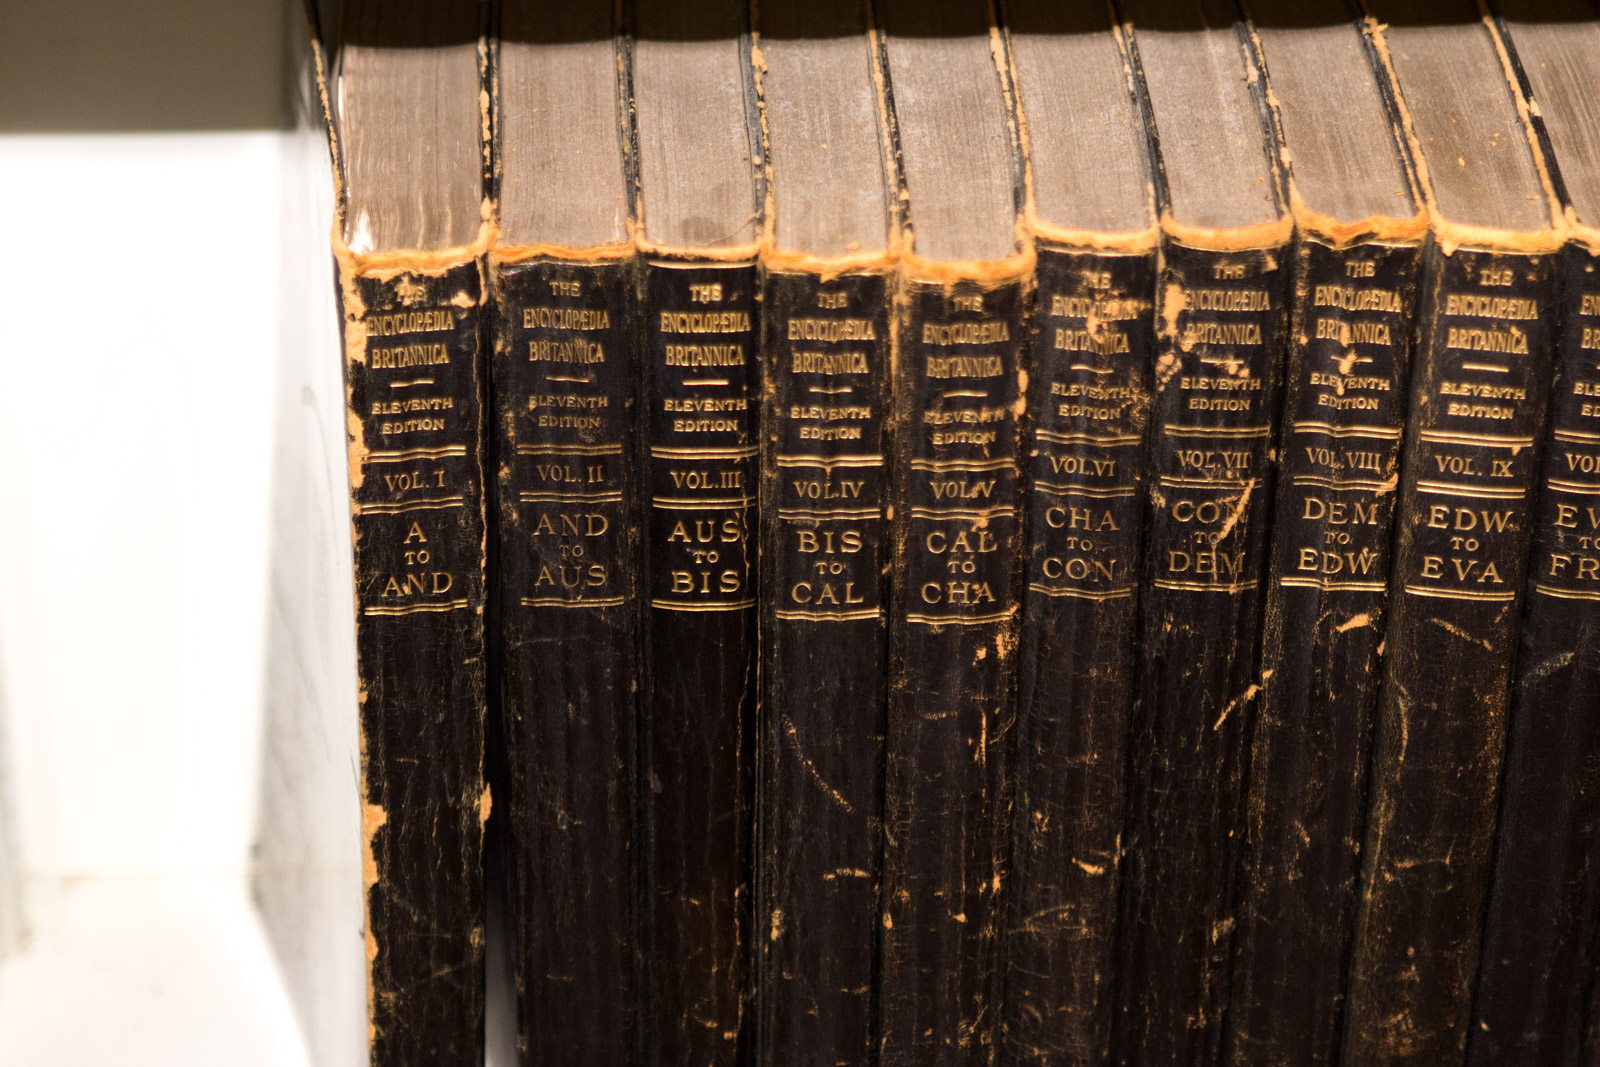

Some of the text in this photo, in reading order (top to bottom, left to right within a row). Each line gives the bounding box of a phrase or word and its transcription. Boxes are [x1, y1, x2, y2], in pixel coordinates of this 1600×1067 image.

[1214, 264, 1245, 279] THE
[1345, 262, 1375, 277] THE
[1480, 270, 1512, 286] THE
[1082, 272, 1111, 288] THE
[550, 282, 580, 297] THE
[690, 285, 722, 301] THE
[817, 293, 846, 307] THE
[953, 297, 983, 312] THE
[1315, 286, 1401, 312] ENCYCLOPÆDIA
[1445, 294, 1538, 319] ENCYCLOPÆDIA
[366, 311, 454, 336] ENCYCLOPÆDIA
[523, 308, 610, 330] ENCYCLOPÆDIA
[661, 313, 751, 333] ENCYCLOPÆDIA
[788, 320, 876, 341] ENCYCLOPÆDIA
[922, 323, 1009, 344] ENCYCLOPÆDIA
[1055, 329, 1129, 353] BRITANNICA
[1447, 328, 1529, 354] BRITANNICA
[372, 345, 450, 368] BRITANNICA
[529, 342, 605, 363] BRITANNICA
[666, 346, 745, 367] BRITANNICA
[793, 353, 869, 374] BRITANNICA
[927, 356, 1003, 378] BRITANNICA
[1050, 382, 1130, 399] ELEVENTH
[1181, 378, 1261, 390] ELEVENTH
[1310, 373, 1390, 391] ELEVENTH
[1440, 383, 1526, 399] ELEVENTH
[371, 398, 453, 414] ELEVENTH
[529, 396, 608, 408] ELEVENTH
[664, 400, 747, 411] ELEVENTH
[1189, 398, 1250, 410] EDITION
[1318, 395, 1378, 410] EDITION
[790, 407, 871, 419] ELEVENTH
[924, 409, 1005, 424] ELEVENTH
[1058, 405, 1120, 419] EDITION
[1448, 404, 1513, 419] EDITION
[382, 419, 445, 434] EDITION
[539, 416, 600, 428] EDITION
[674, 420, 738, 432] EDITION
[800, 427, 861, 440] EDITION
[932, 432, 995, 445] EDITION
[1222, 452, 1248, 469] VII
[1346, 452, 1380, 469] VIII
[1491, 460, 1513, 477] IX
[436, 471, 445, 487] I
[588, 466, 604, 482] II
[1046, 507, 1119, 531] CHA
[1172, 501, 1247, 523] CON
[1302, 498, 1377, 525] DEM
[1427, 505, 1513, 533] EDW
[404, 522, 427, 544] A
[533, 514, 609, 536] AND
[667, 521, 740, 543] AUS
[797, 532, 862, 553] BIS
[926, 532, 997, 553] CAL
[1067, 537, 1092, 550] TO
[1195, 531, 1219, 544] TO
[1325, 532, 1350, 544] TO
[1450, 537, 1479, 551] TO
[405, 551, 429, 565] TO
[560, 545, 584, 557] TO
[692, 551, 719, 563] TO
[816, 562, 843, 574] TO
[948, 560, 976, 574] TO
[1043, 558, 1116, 581] CON
[1168, 551, 1245, 573] DEM
[1298, 549, 1377, 574] EDW
[1421, 556, 1503, 582] EVA
[1549, 554, 1600, 579] FR
[382, 573, 453, 597] AND
[534, 566, 606, 587] AUS
[671, 572, 740, 593] BIS
[791, 583, 863, 604] CAL
[921, 582, 995, 604] CHA
